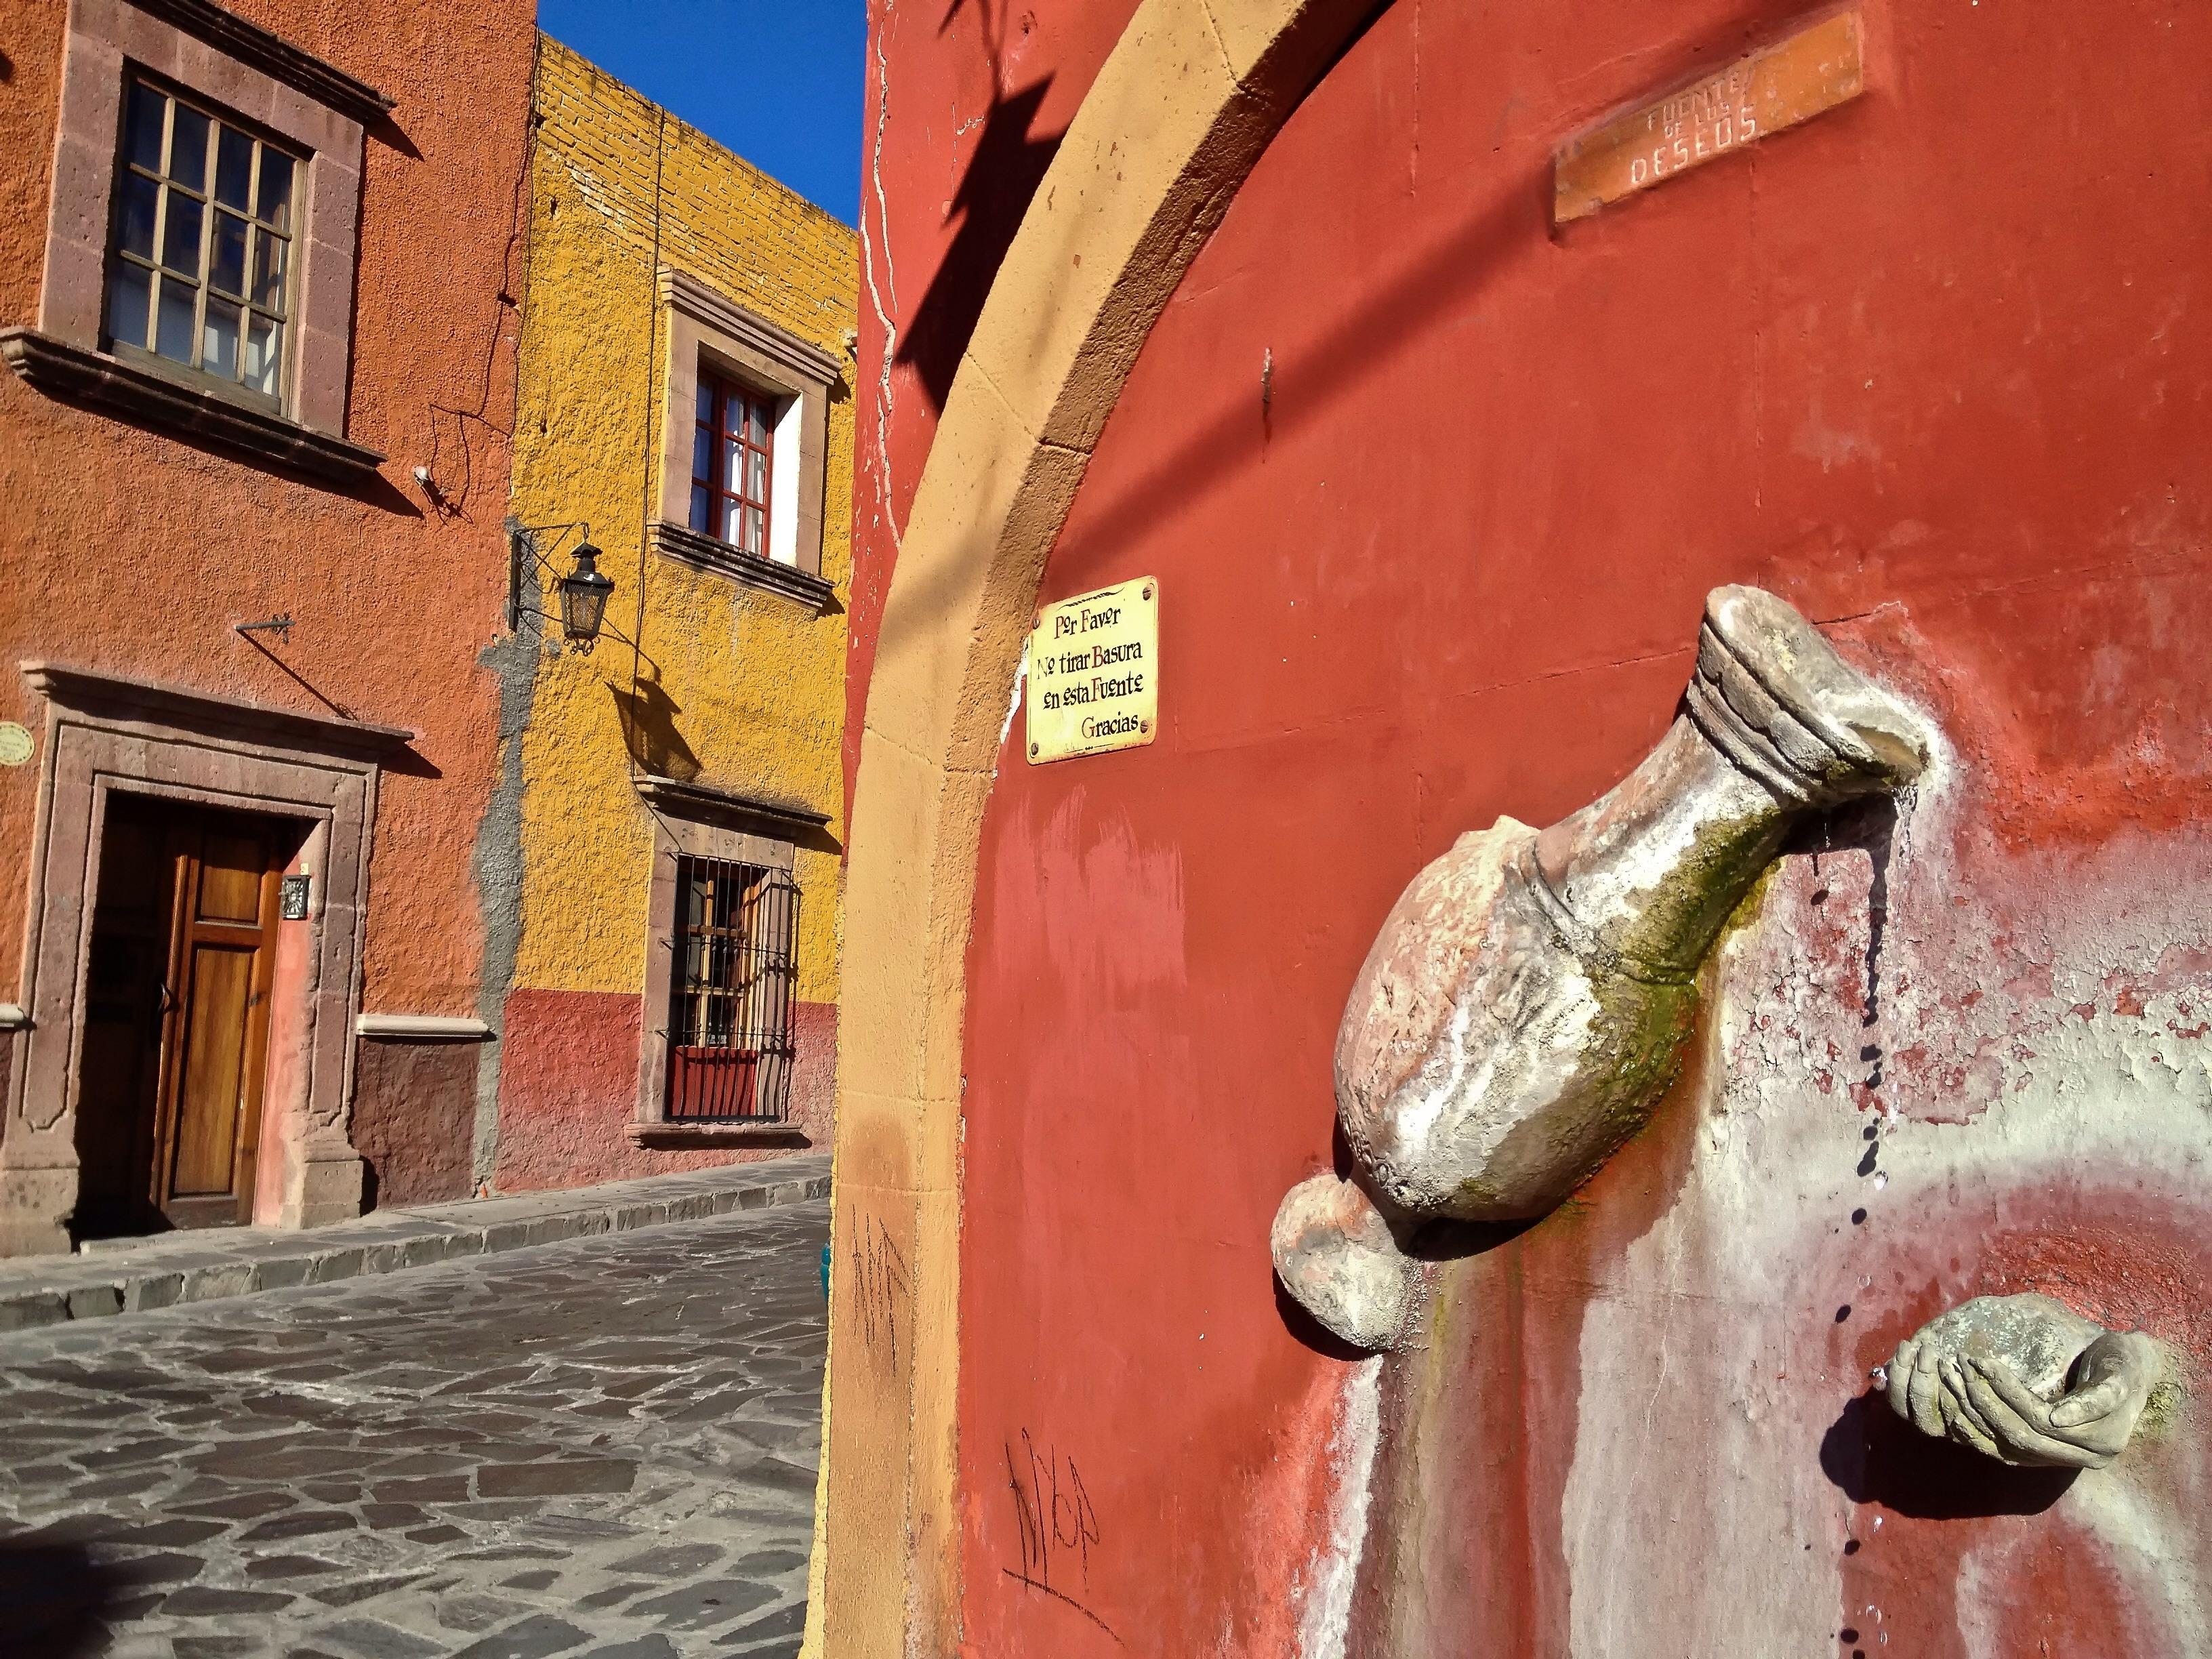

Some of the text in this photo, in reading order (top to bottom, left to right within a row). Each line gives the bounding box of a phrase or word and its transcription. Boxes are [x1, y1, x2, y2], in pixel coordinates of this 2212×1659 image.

[1631, 103, 1756, 184] DESEOS
[1054, 607, 1121, 639] Por Favor
[1037, 642, 1143, 680] No tirar Basura
[1043, 670, 1144, 710] en esta Fuente
[1082, 712, 1139, 739] Gracias
